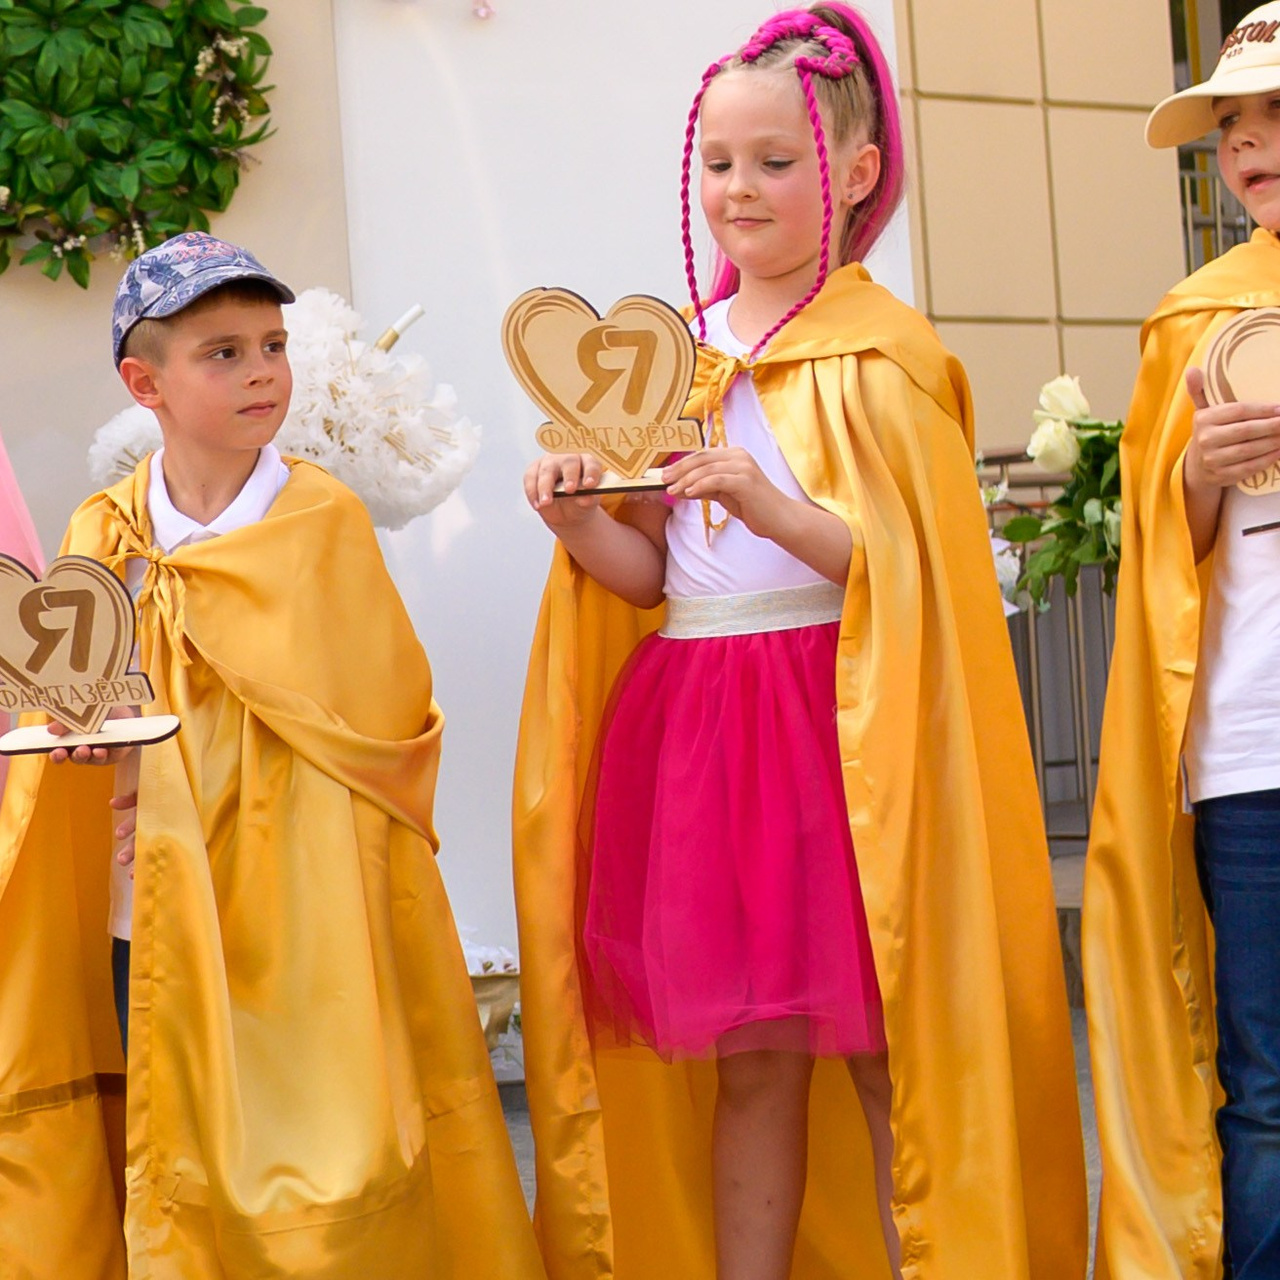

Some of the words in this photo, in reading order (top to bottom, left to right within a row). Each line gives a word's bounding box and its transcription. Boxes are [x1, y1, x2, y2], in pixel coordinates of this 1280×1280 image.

[577, 324, 658, 415] Я
[540, 422, 697, 449] ФАНТАЗЁРЫ
[18, 586, 96, 674] Я
